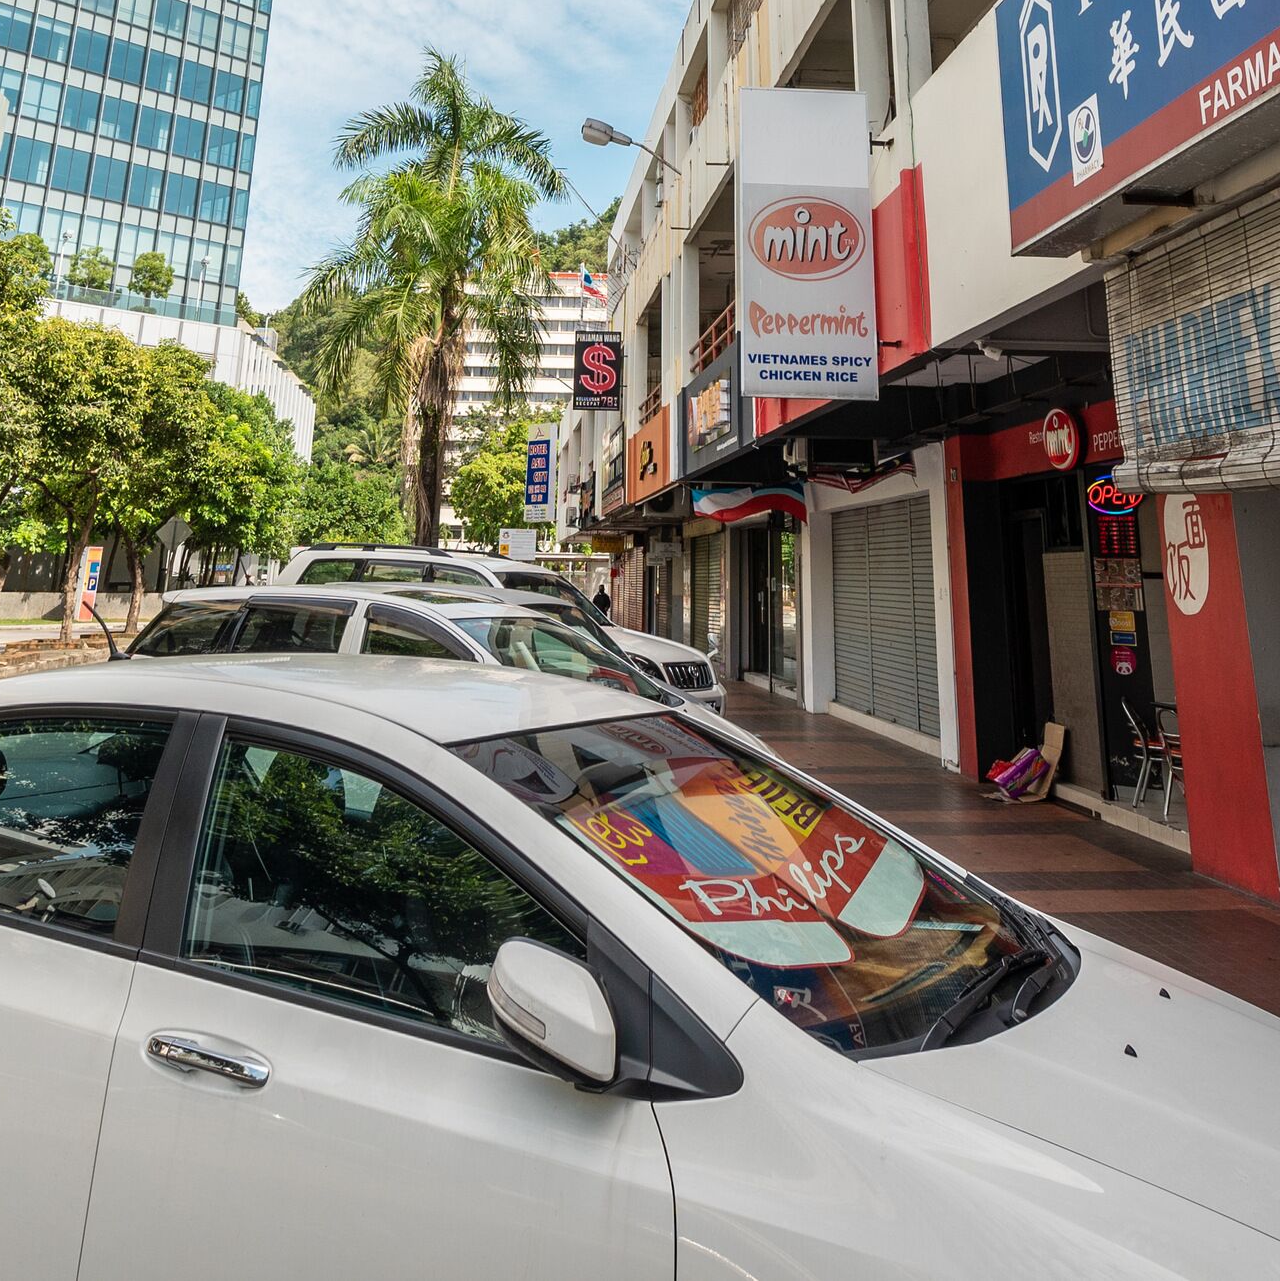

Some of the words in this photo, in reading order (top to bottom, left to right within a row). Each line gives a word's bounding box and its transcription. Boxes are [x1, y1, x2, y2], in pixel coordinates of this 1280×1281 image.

[763, 206, 851, 262] mint
[748, 300, 868, 339] Peppermint
[748, 353, 827, 366] VIETNAMES
[832, 355, 872, 367] SPICY
[759, 369, 822, 382] CHICKEN
[827, 372, 858, 383] RICE
